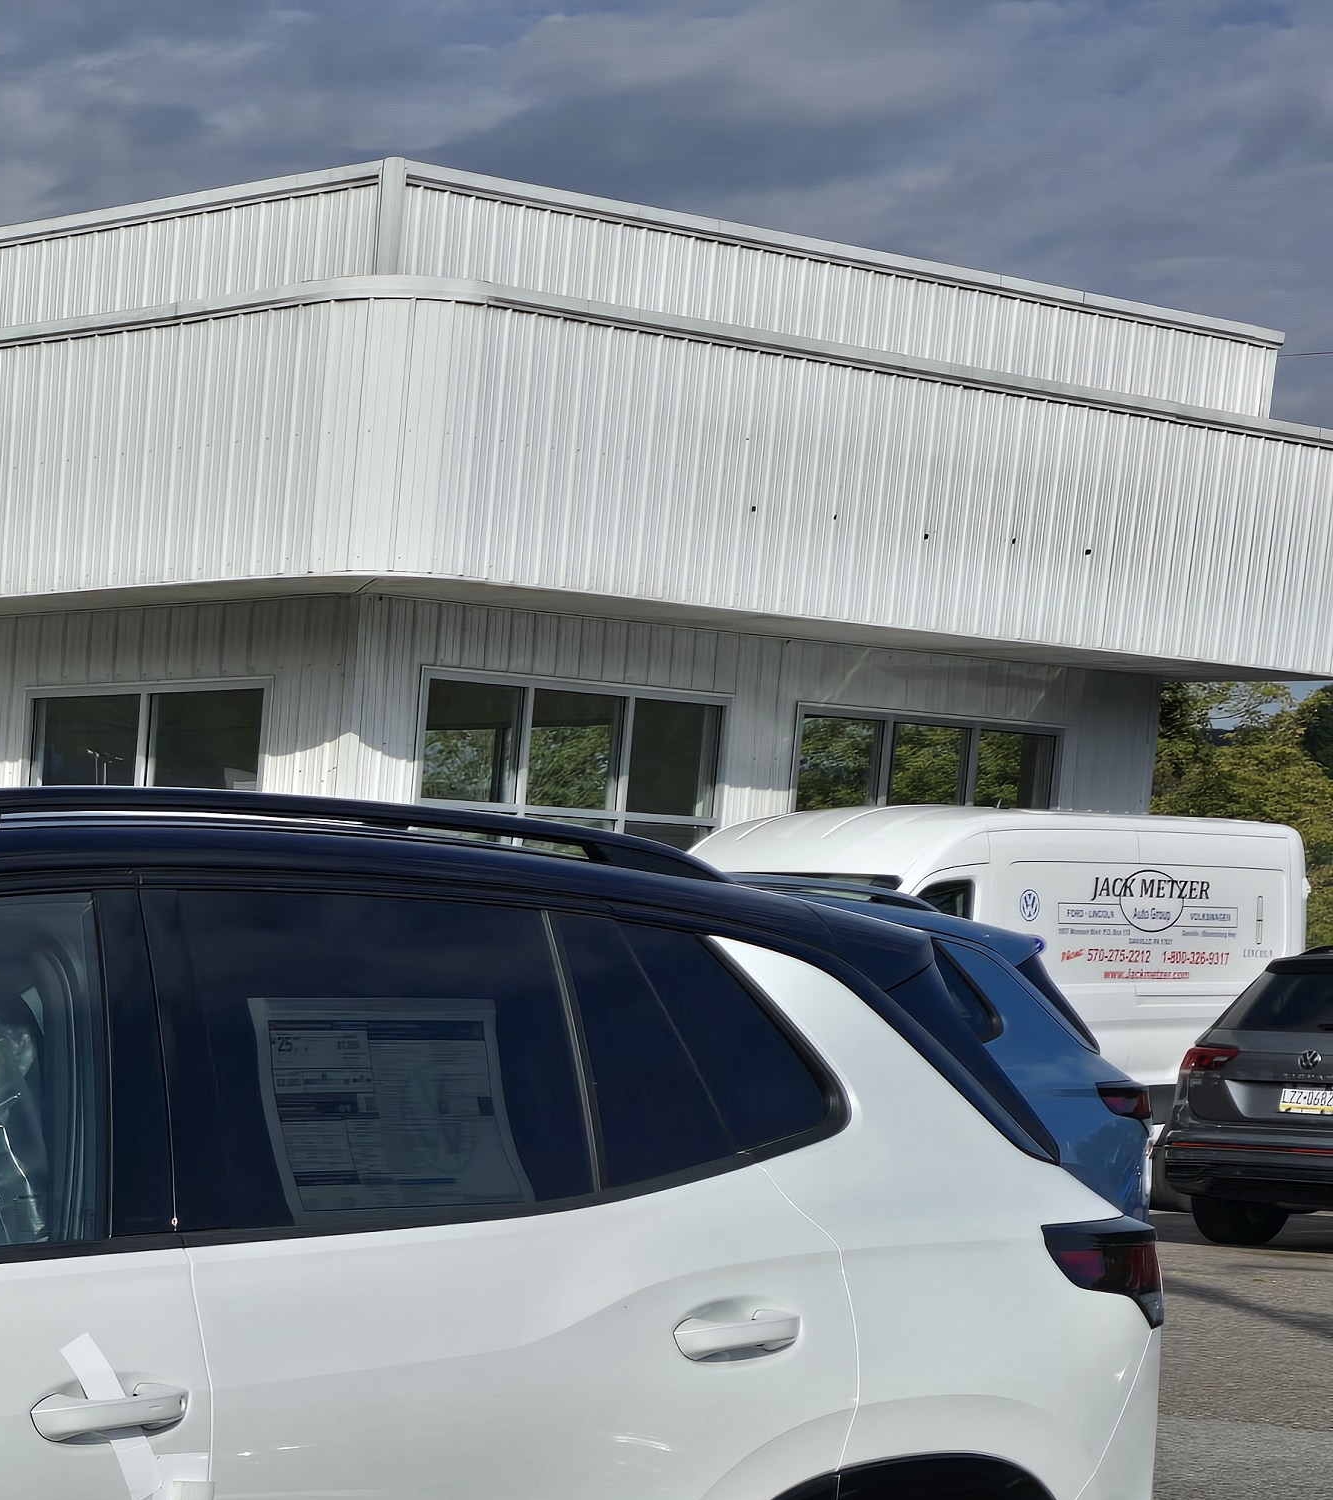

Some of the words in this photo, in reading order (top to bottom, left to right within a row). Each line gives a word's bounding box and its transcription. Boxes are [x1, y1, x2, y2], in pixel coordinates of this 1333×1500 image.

[1090, 877, 1136, 902] JACK
[1139, 878, 1211, 900] METZER
[1132, 907, 1149, 920] Auto
[1151, 907, 1172, 923] Group
[1087, 948, 1151, 963] 570-275-2212
